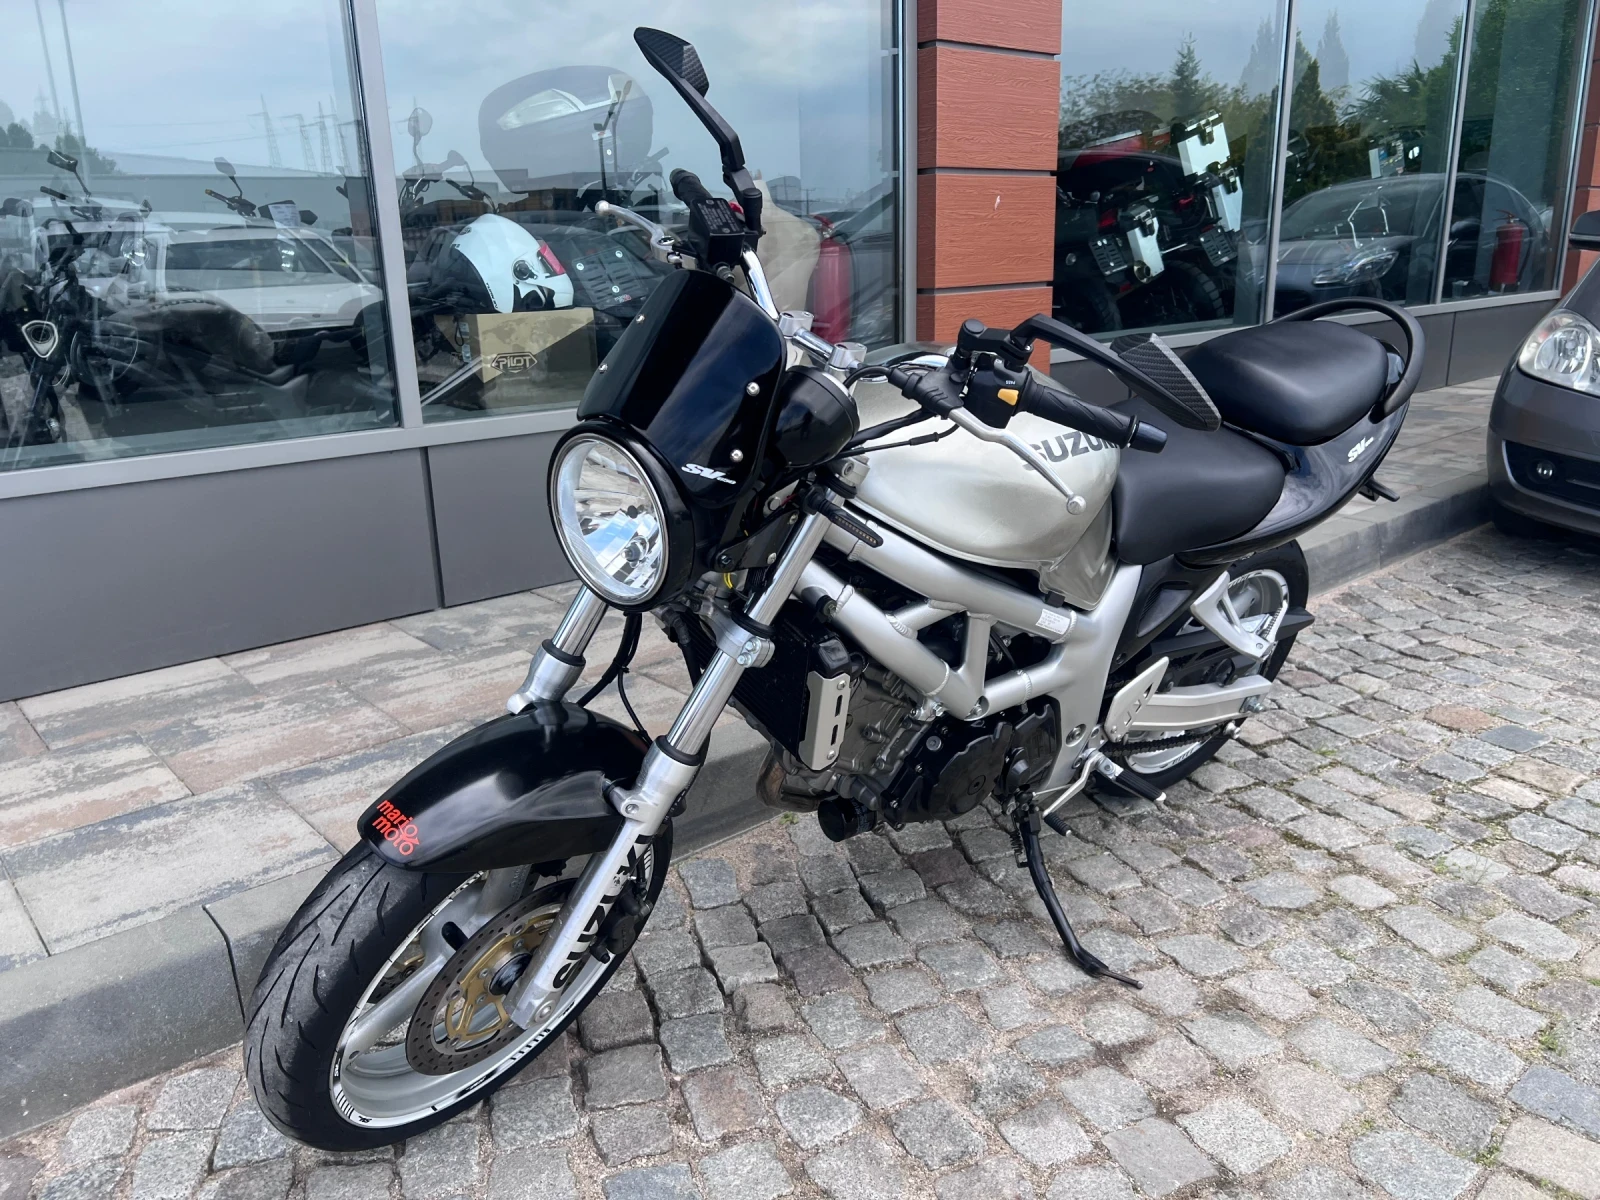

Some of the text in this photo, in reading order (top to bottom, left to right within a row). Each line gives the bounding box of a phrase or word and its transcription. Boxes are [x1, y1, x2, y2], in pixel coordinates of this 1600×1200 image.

[1022, 430, 1118, 471] SUZU
[371, 815, 414, 856] moto
[376, 799, 418, 838] mario
